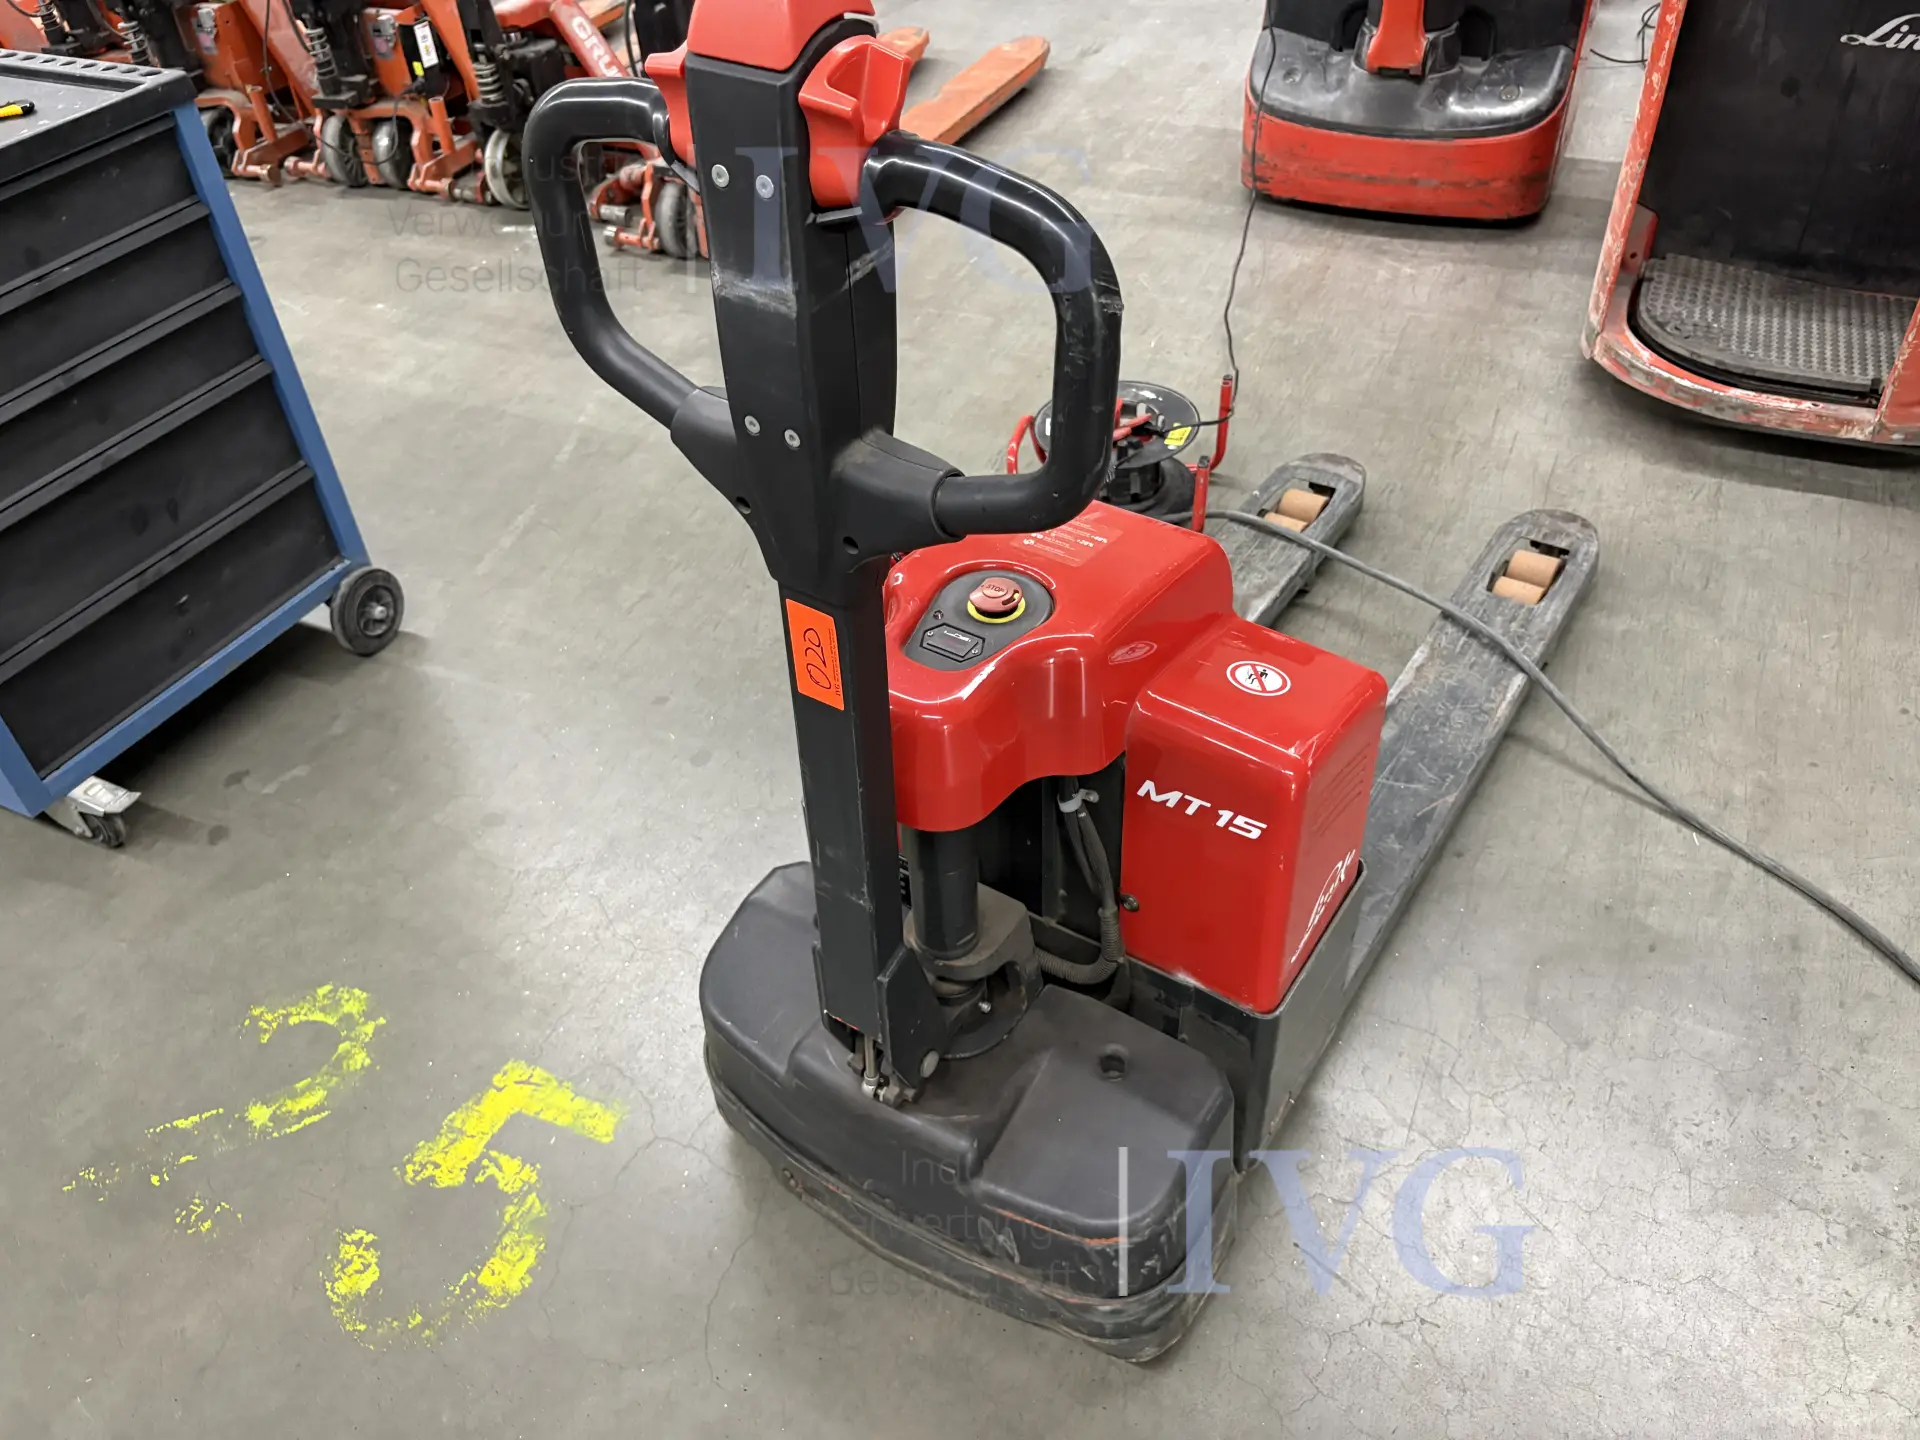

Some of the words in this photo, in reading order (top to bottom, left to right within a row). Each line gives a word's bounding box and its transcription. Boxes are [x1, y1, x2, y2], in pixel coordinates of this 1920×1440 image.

[571, 16, 623, 77] GRU
[985, 583, 1005, 593] STOP
[1137, 779, 1211, 816] MT
[1215, 809, 1268, 840] 15
